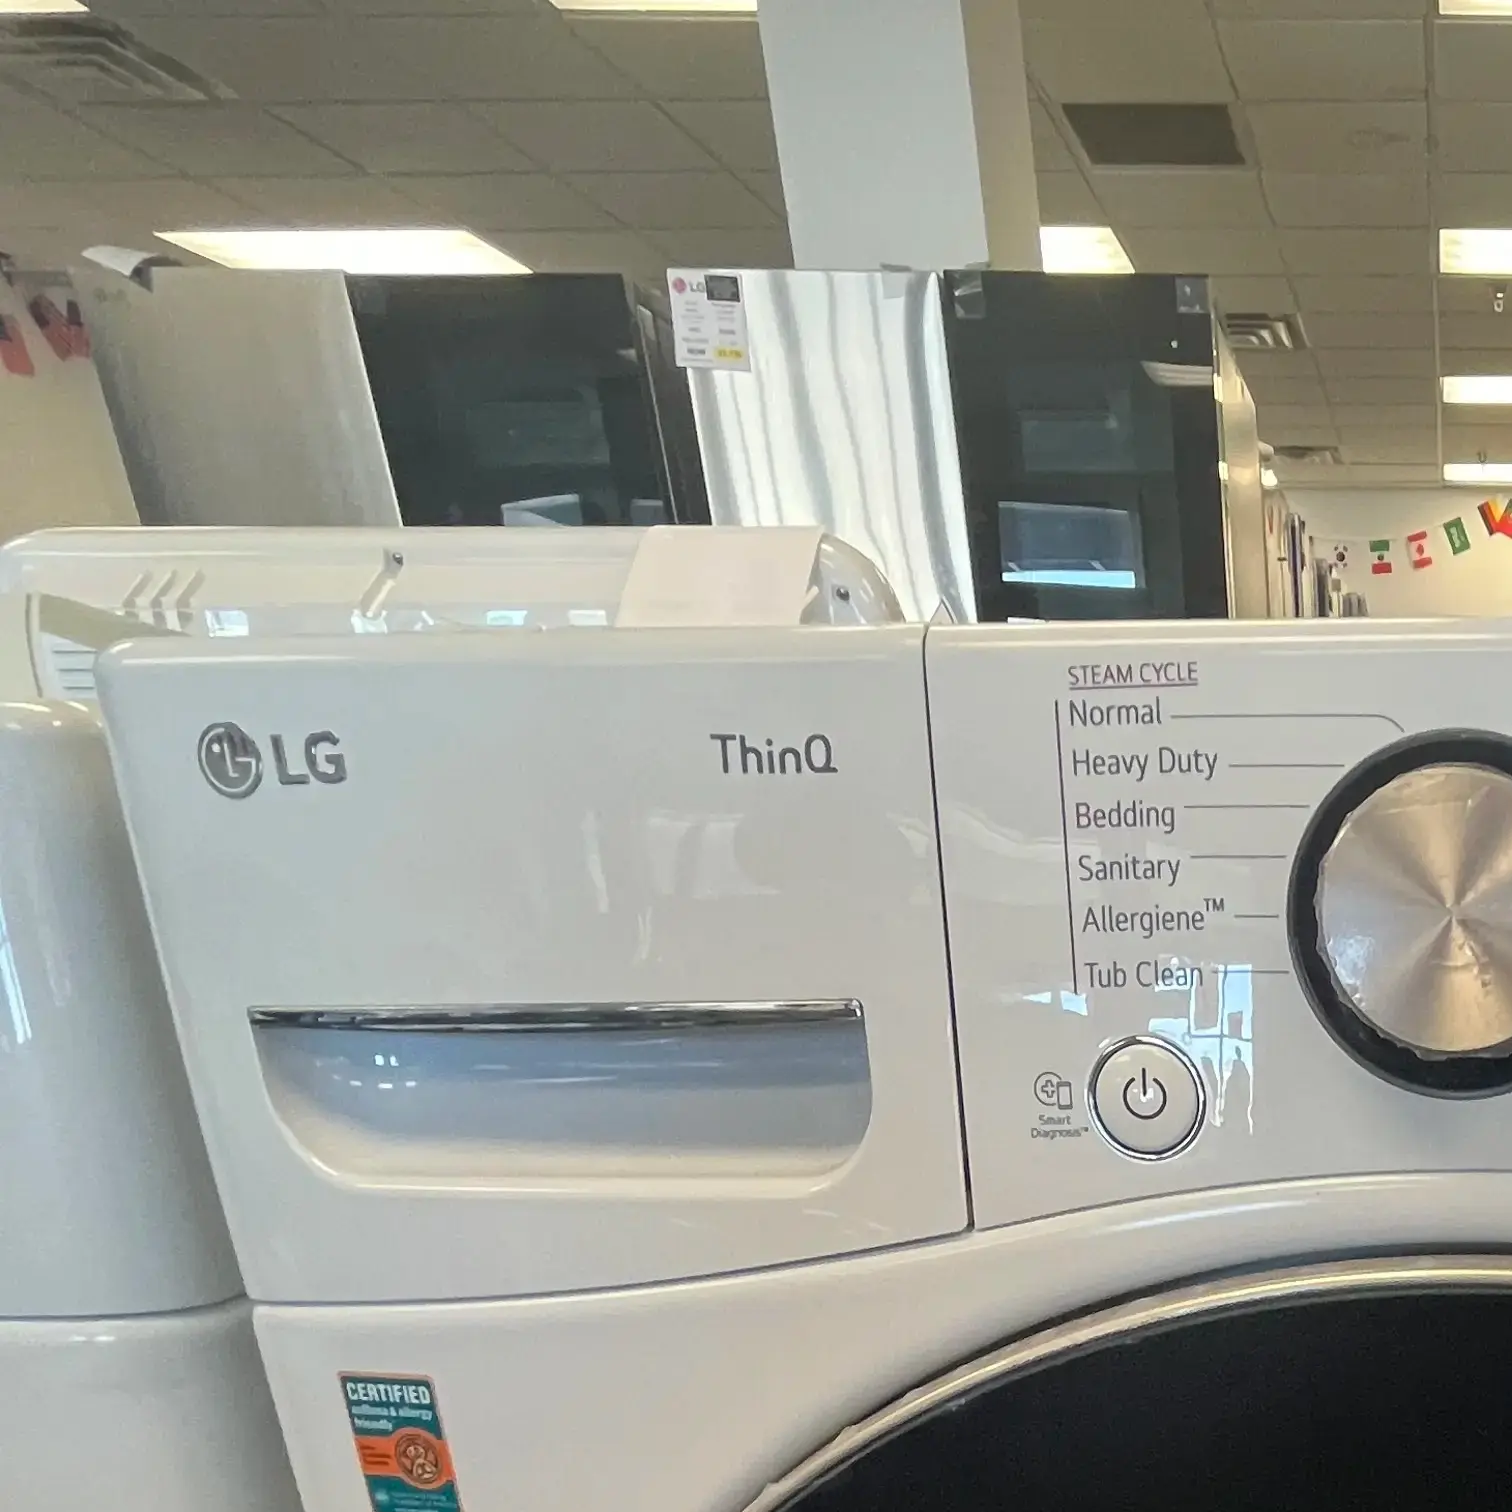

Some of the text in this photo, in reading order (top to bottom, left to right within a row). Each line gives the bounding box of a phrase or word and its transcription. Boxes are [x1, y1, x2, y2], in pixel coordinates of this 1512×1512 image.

[1068, 662, 1198, 685] STEAM CYCLE
[1069, 696, 1162, 727] Normal
[270, 730, 347, 786] LG
[710, 733, 839, 774] ThinQ
[1072, 746, 1218, 782] Heavy Duty
[1075, 800, 1175, 834] Bedding
[1078, 853, 1181, 887] Sanitary
[1084, 958, 1203, 988] Tub Clean
[1038, 1114, 1072, 1126] Smart
[346, 1382, 431, 1404] CERTIFIED
